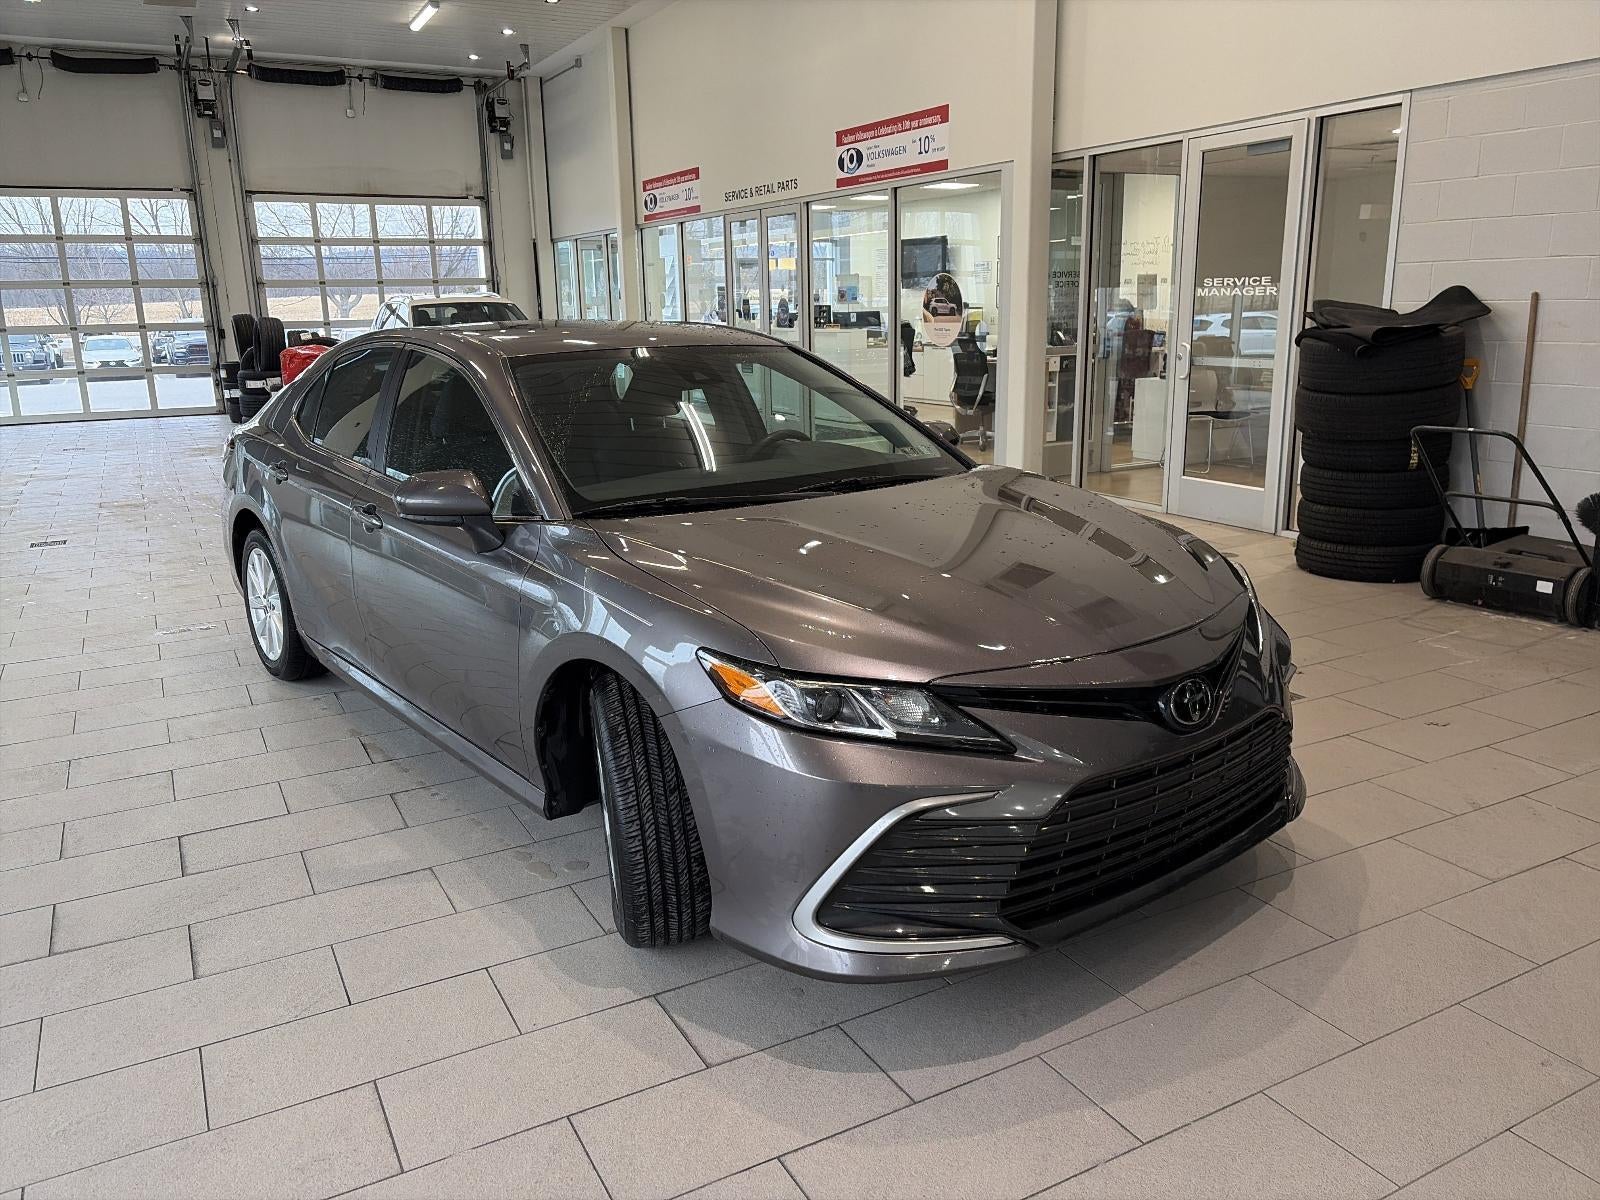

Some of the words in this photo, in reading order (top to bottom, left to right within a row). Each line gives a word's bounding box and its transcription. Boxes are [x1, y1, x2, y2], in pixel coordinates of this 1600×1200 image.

[866, 145, 907, 161] VOLKSWAGEN
[724, 188, 749, 202] SERVICE
[749, 187, 754, 198] &
[754, 183, 776, 197] RETAIL
[777, 178, 798, 193] PARTS
[1203, 276, 1272, 287] SERVICE
[1197, 286, 1278, 296] MANAGER
